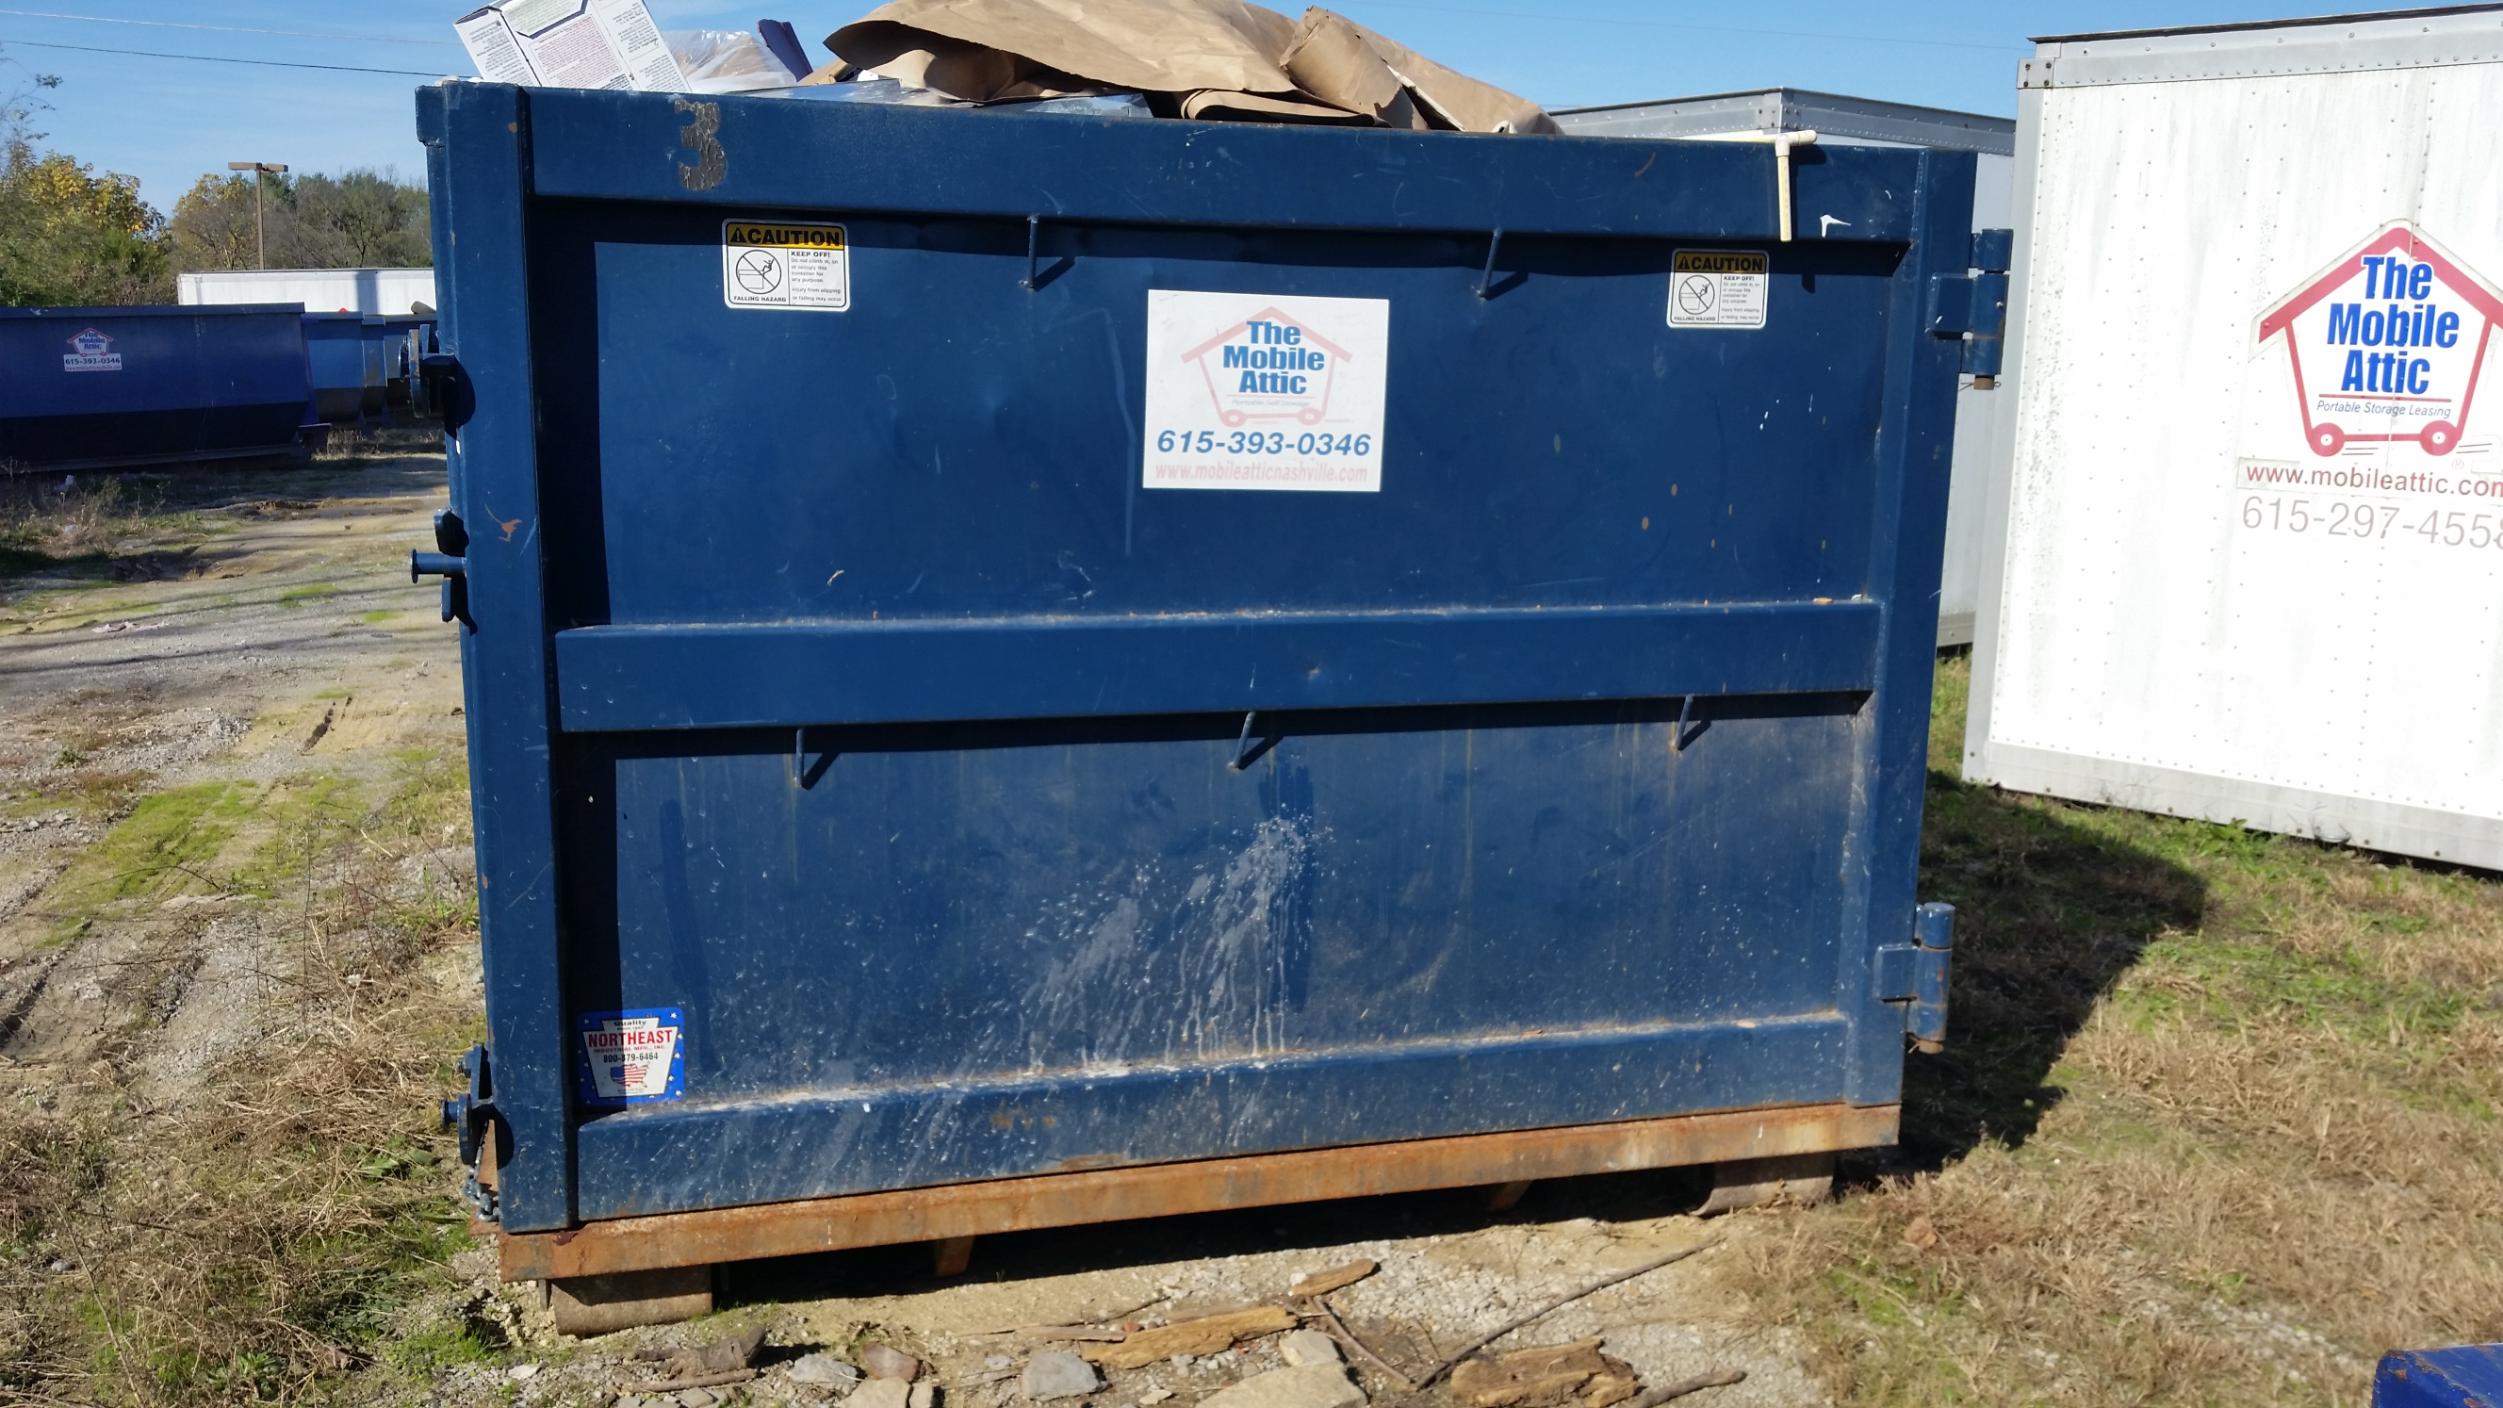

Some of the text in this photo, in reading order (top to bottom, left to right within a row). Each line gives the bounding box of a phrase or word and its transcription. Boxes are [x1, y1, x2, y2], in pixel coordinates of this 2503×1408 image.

[673, 98, 727, 191] 3
[747, 228, 840, 246] CAUTION
[1691, 256, 1763, 271] CAUTION
[2363, 256, 2433, 301] The
[1246, 320, 1301, 345] The
[2327, 303, 2459, 348] Mobile
[65, 357, 120, 365] 615-393-0346
[1223, 345, 1325, 371] Mobile
[1239, 370, 1307, 394] Attic
[2341, 350, 2431, 395] Attic
[2316, 399, 2451, 419] Portable Storage Leasing
[1157, 430, 1372, 456] 615-393-0346
[1155, 462, 1368, 482] www.mobileatticnashville.com
[588, 1030, 672, 1047] NORTHEAST
